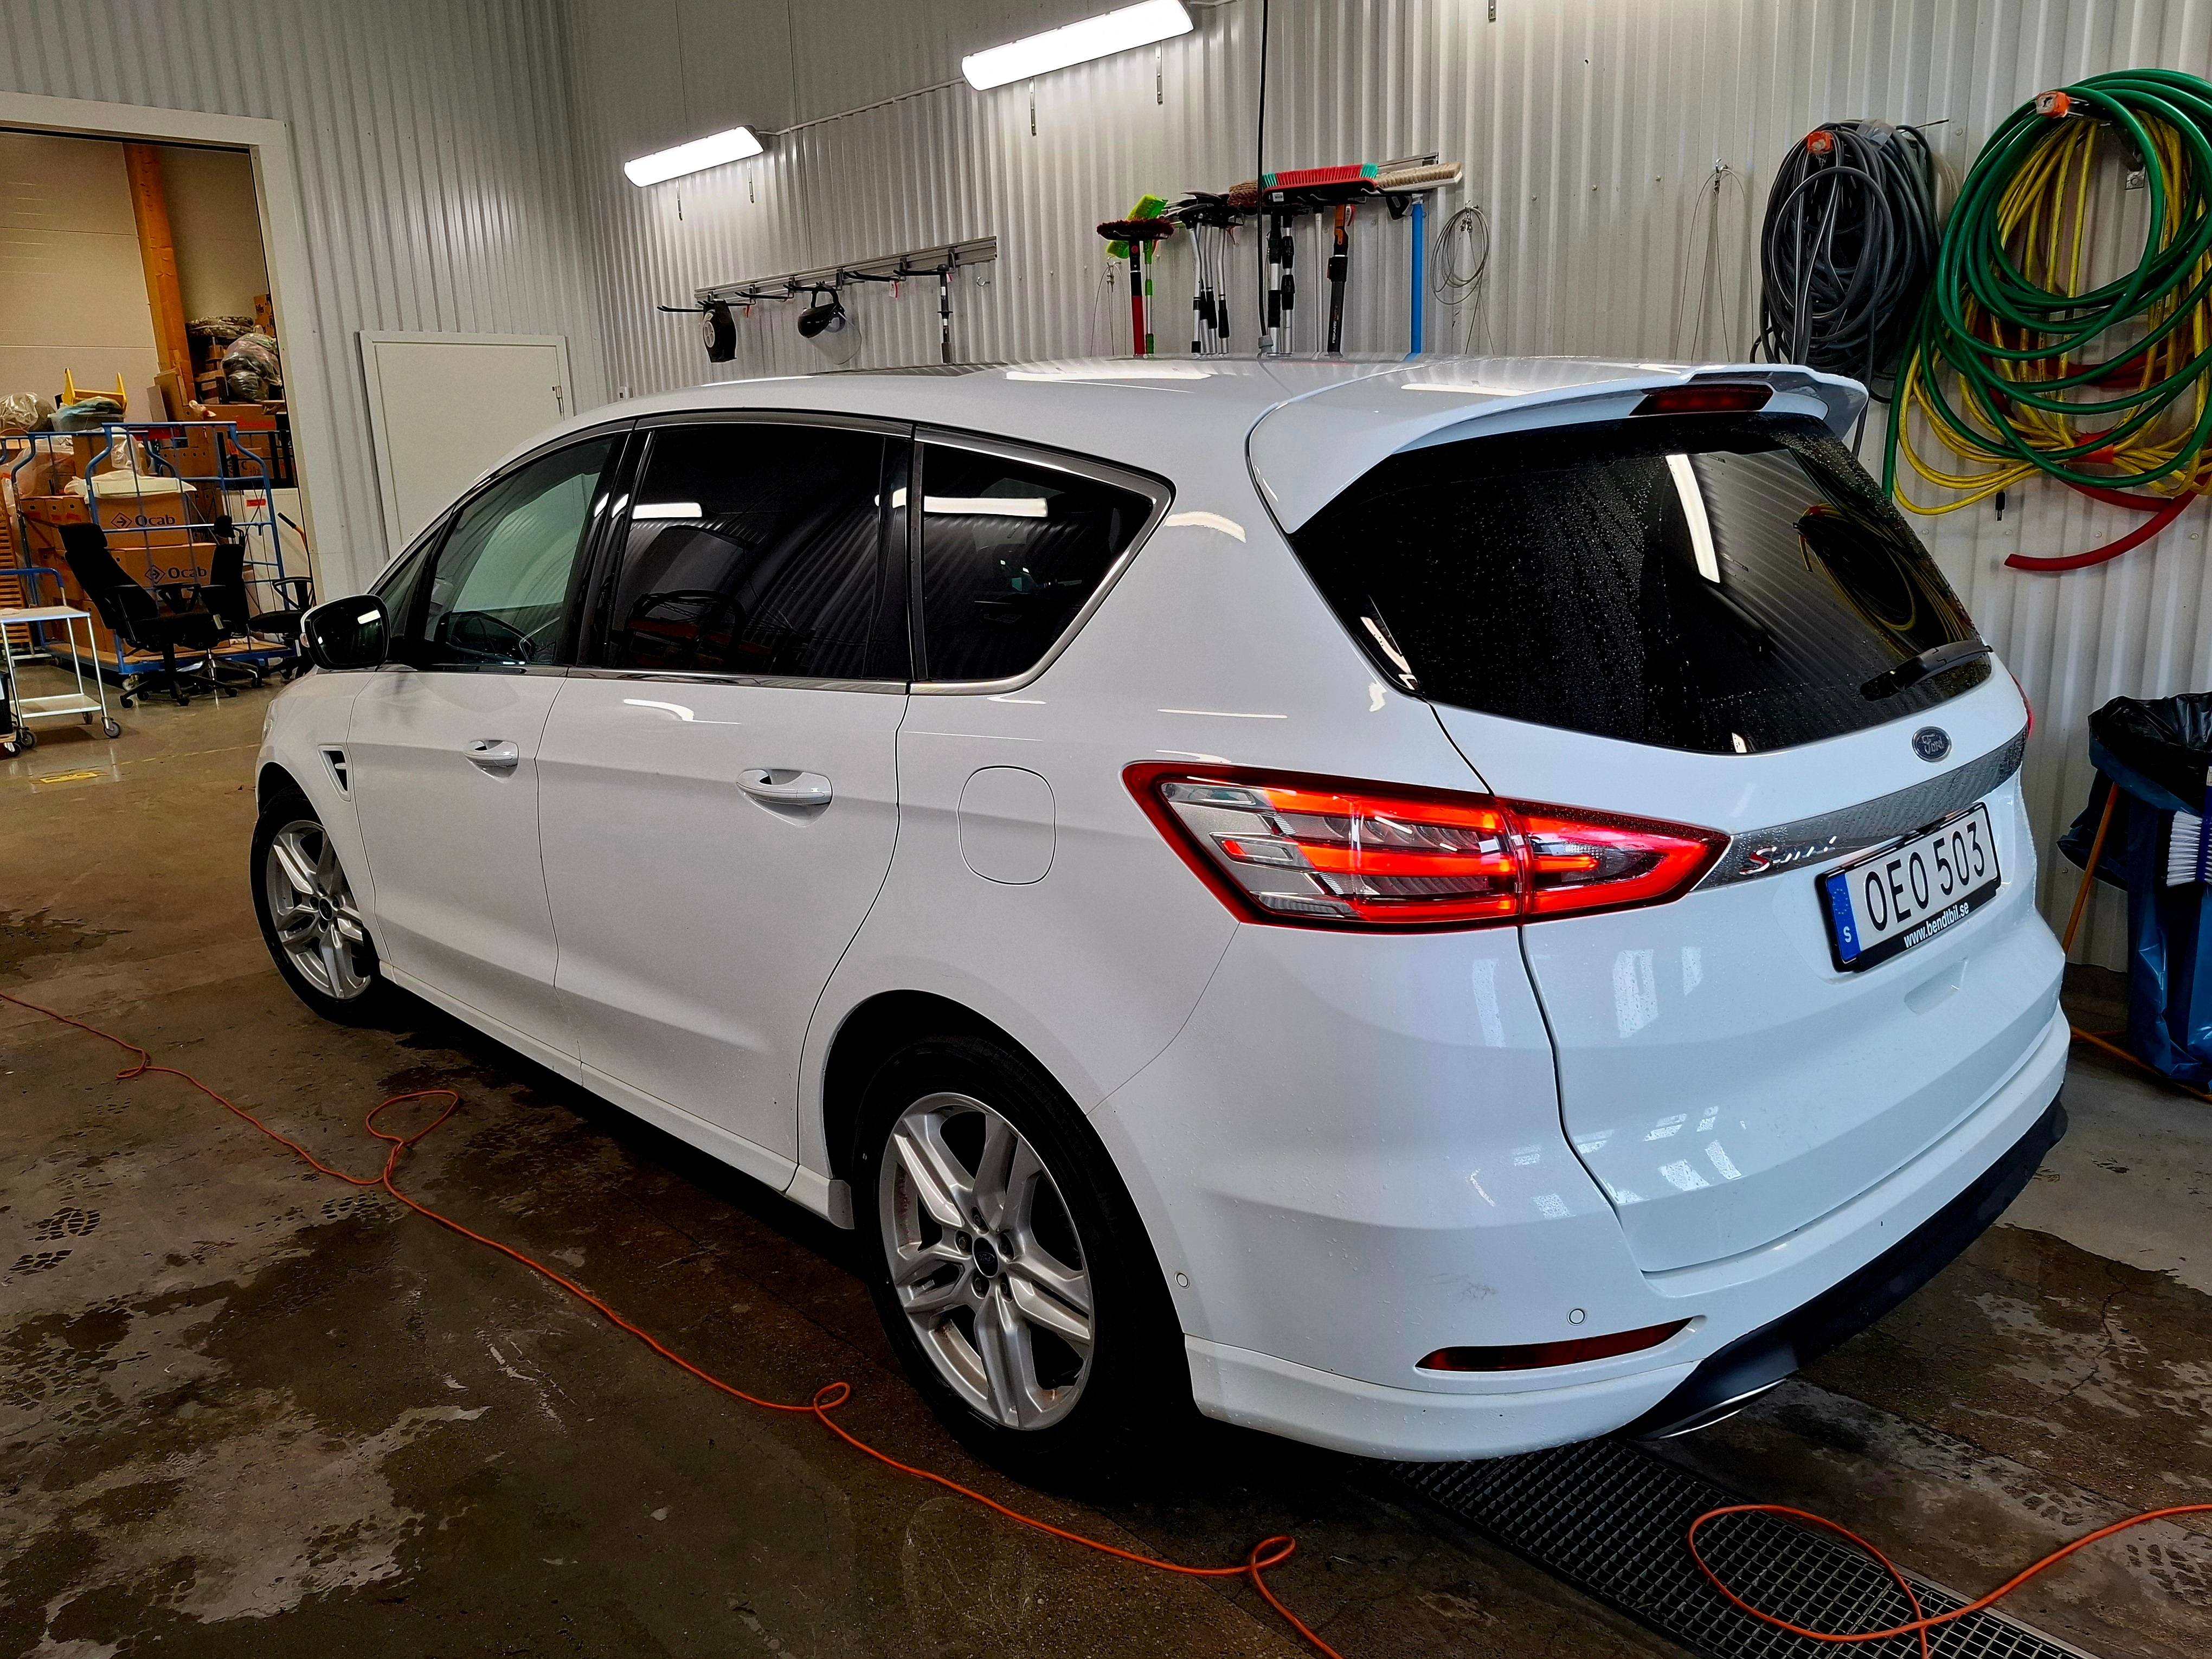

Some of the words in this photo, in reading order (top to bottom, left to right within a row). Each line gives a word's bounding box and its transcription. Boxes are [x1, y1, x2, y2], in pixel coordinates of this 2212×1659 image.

[135, 515, 175, 526] Ocab
[168, 566, 207, 579] Ocab
[1921, 734, 1945, 754] Ford
[1865, 852, 1929, 931] OEO
[1933, 821, 1985, 896] 503
[1904, 902, 1969, 948] www.bendtbil.se
[1843, 927, 1852, 943] S
